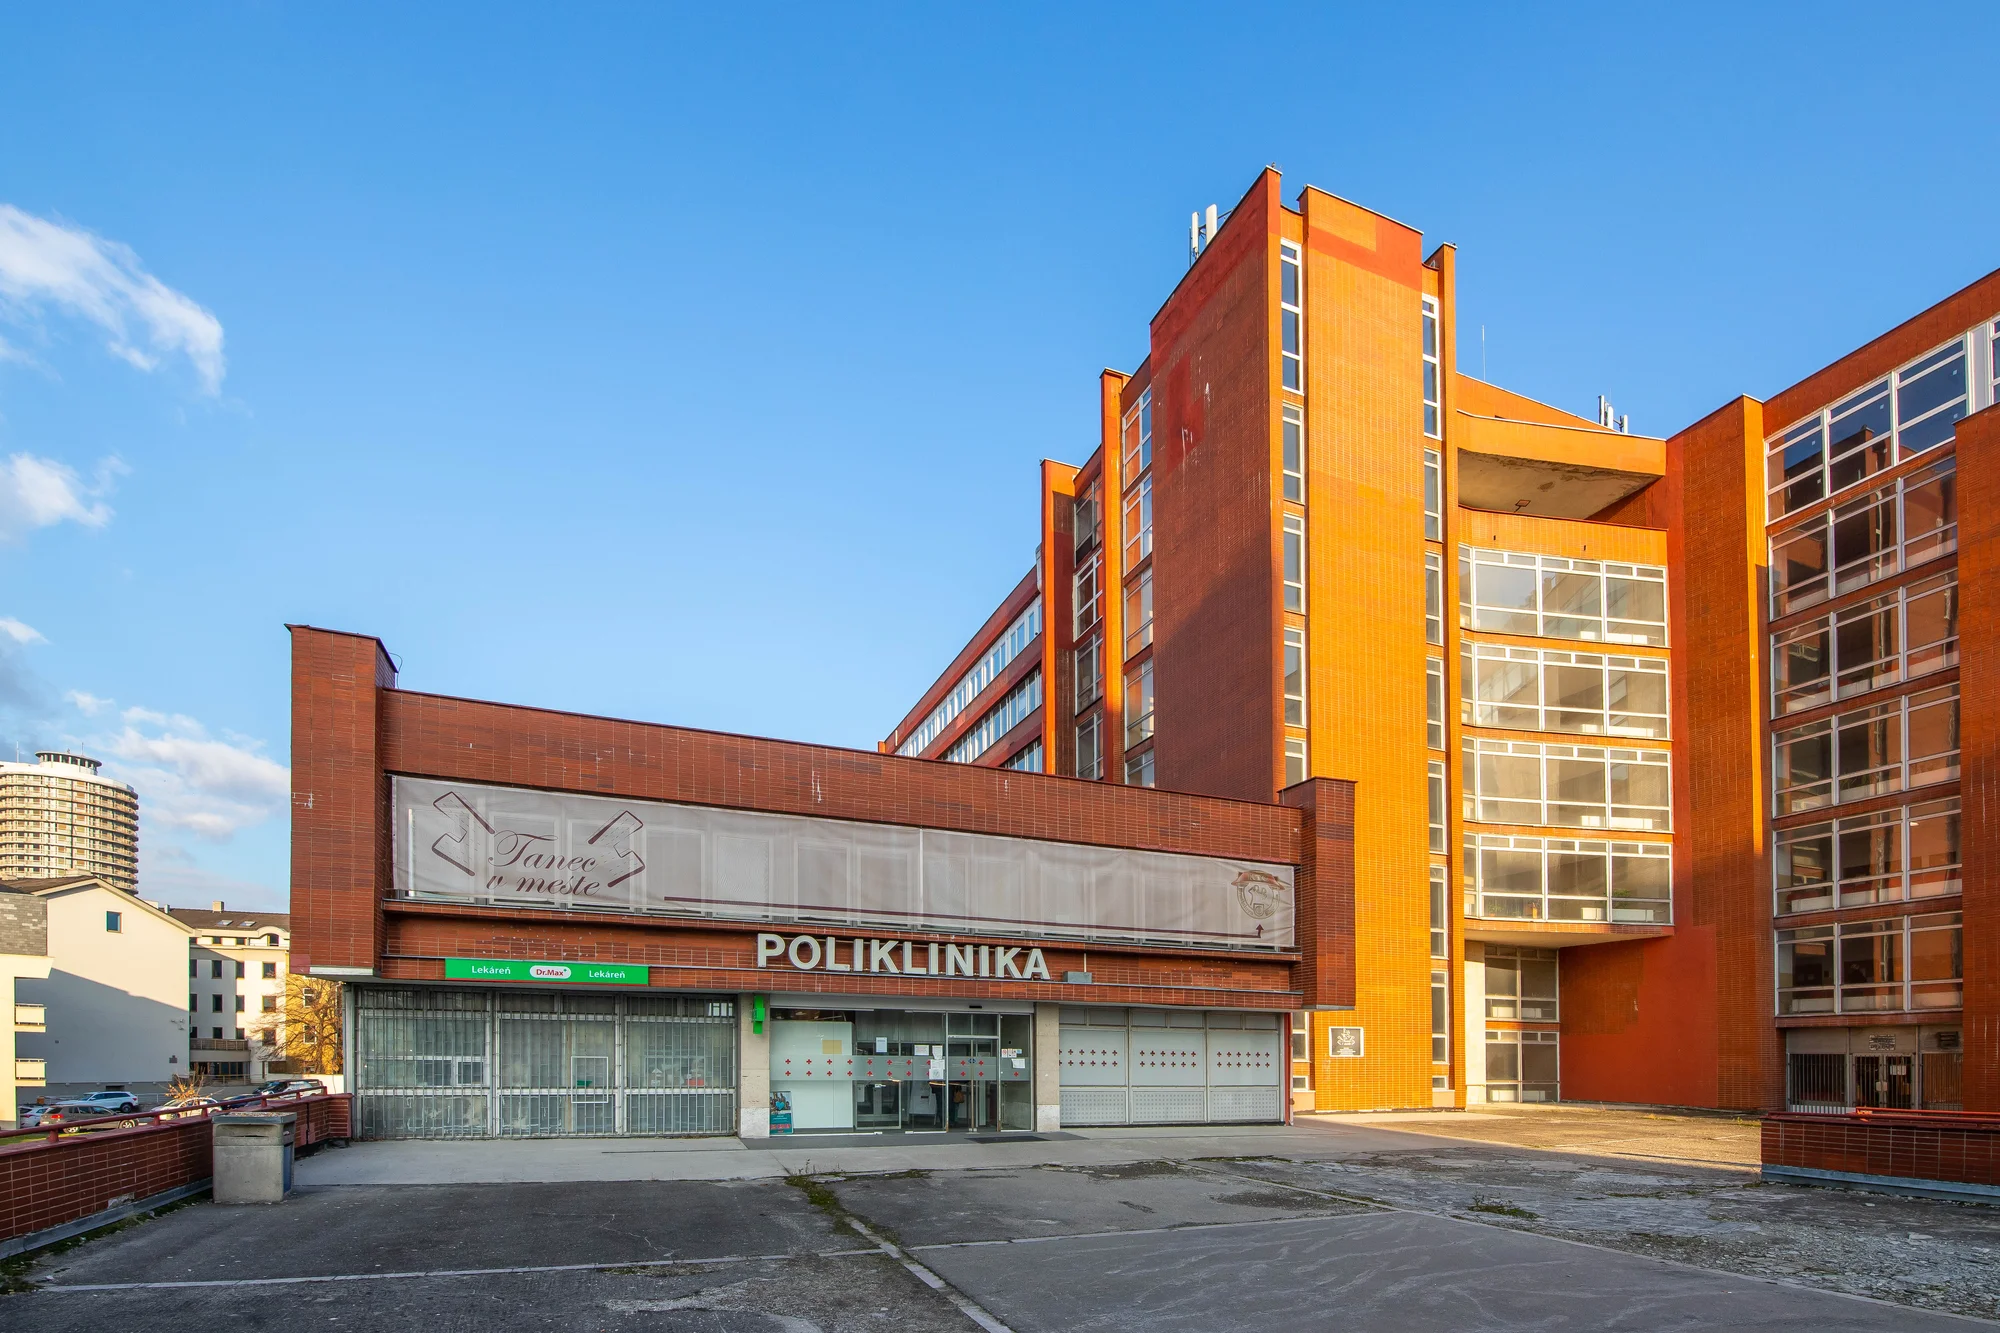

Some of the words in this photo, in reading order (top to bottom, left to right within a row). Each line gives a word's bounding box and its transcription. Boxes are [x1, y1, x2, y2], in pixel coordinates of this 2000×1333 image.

[488, 830, 599, 872] Tanec
[486, 876, 506, 890] v
[516, 876, 600, 896] meste
[471, 965, 511, 975] Lekáreň
[589, 970, 626, 979] Lekáreň
[757, 933, 1051, 980] POLIKLINIKA
